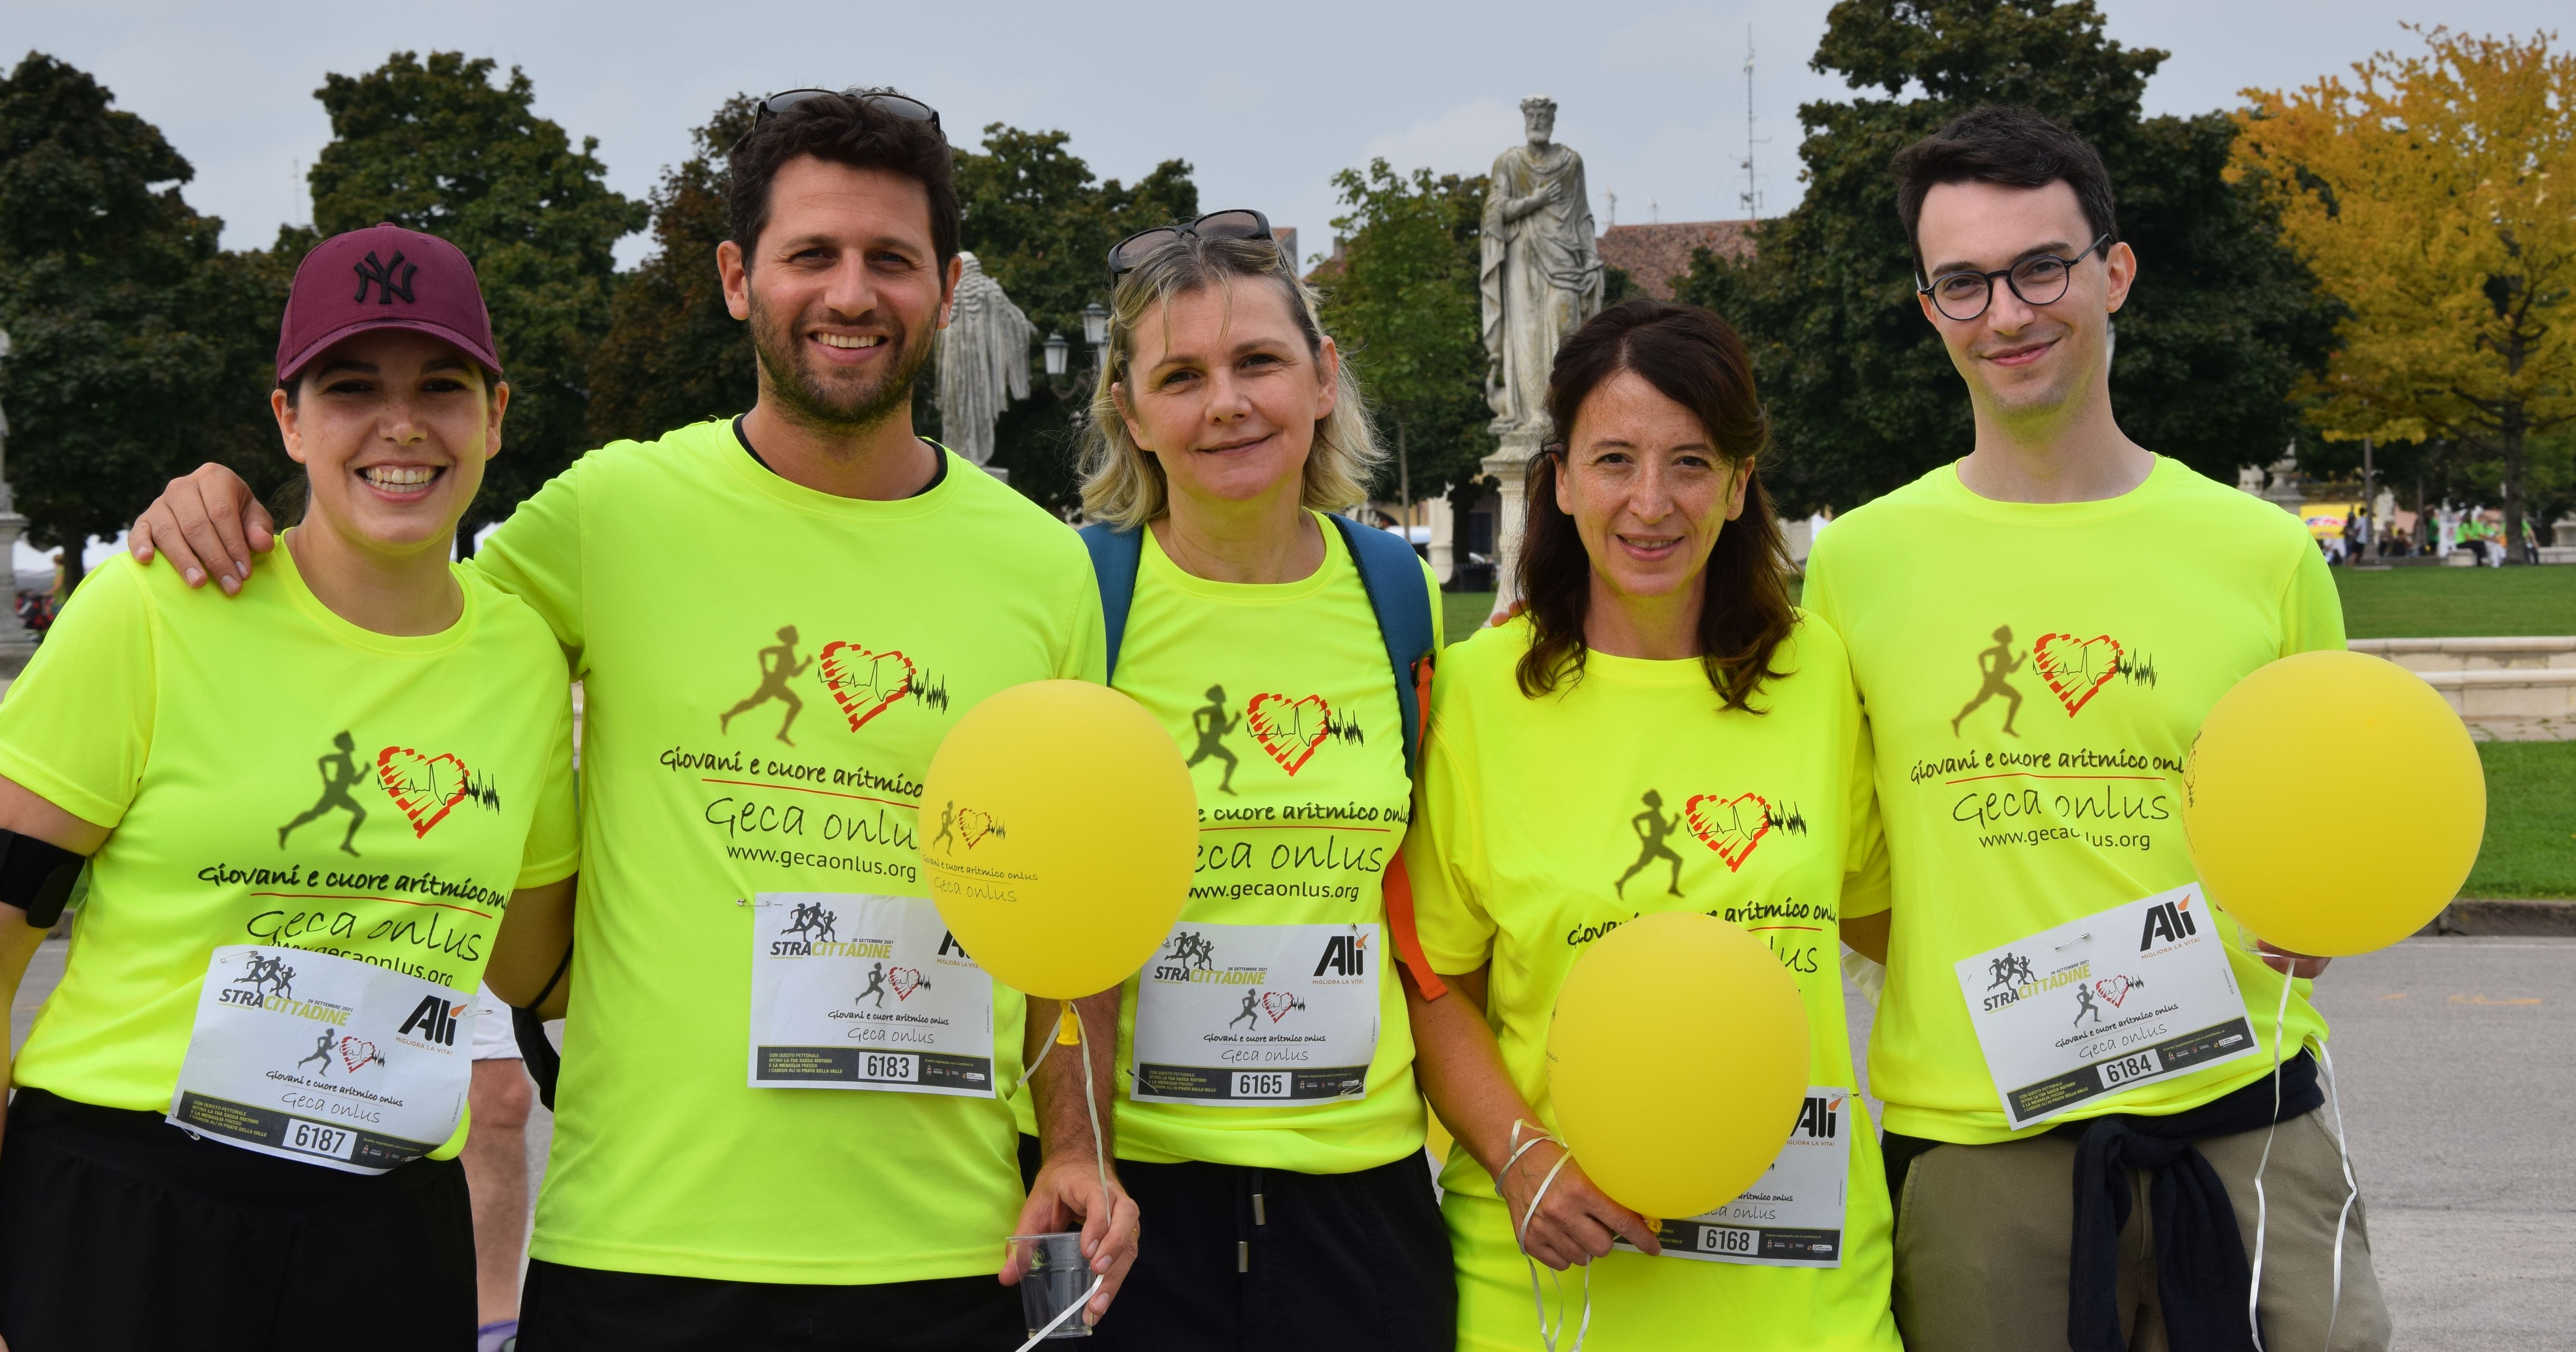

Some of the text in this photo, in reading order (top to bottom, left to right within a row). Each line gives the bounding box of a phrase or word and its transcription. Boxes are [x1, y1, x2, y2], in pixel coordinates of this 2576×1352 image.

[660, 746, 923, 798] Giovani e cuore aritmico
[1911, 748, 2185, 784] Giovani e cuore aritmico onl
[1199, 809, 1206, 822] e
[1214, 805, 1276, 821] cuore
[1283, 802, 1378, 821] aritmico
[1953, 789, 2042, 830] Geca
[2055, 785, 2169, 820] onlus
[705, 797, 919, 850] Geca onlu
[727, 845, 917, 883] www.gecaonlus.org
[1195, 835, 1382, 872] eca onlus
[946, 863, 964, 873] cuore
[967, 865, 1004, 879] aritmico
[1008, 871, 1038, 881] onlus
[198, 864, 300, 887] Giovani
[308, 868, 319, 886] e
[326, 871, 390, 891] cuore
[394, 872, 488, 904] aritmico
[934, 877, 1017, 902] Geca onlus
[1725, 896, 1809, 923] aritmico
[247, 910, 481, 961] Geca onlus
[2141, 947, 2172, 959] MIGLIORA
[2057, 963, 2079, 973] SETTEMBRE
[314, 1000, 341, 1009] SETTEMBRE
[828, 1010, 864, 1019] Giovani
[896, 1013, 928, 1024] aritmico
[930, 1017, 949, 1025] onlus
[2056, 1030, 2088, 1048] Giovani
[2096, 1023, 2117, 1034] cuore
[2118, 1012, 2153, 1027] aritmico
[2155, 1004, 2178, 1015] onlus
[395, 1036, 424, 1049] MIGLIORA
[847, 1028, 934, 1044] Geca onlus
[1204, 1034, 1238, 1042] Giovani
[2079, 1024, 2167, 1059] Geca onlus
[1221, 1048, 1309, 1064] Geca onlus
[867, 1056, 910, 1079] 6183
[2106, 1055, 2152, 1083] 6184
[266, 1070, 304, 1084] Giovani
[313, 1081, 337, 1092] cuore
[339, 1086, 377, 1100] aritmico
[379, 1095, 403, 1107] onlus
[1240, 1074, 1283, 1095] 6165
[192, 1115, 209, 1123] CAMION
[201, 1113, 224, 1121] MEDAGLIA
[221, 1107, 247, 1116] PETTORALE
[282, 1093, 380, 1123] Geca onlus
[239, 1116, 259, 1124] RISTORO
[294, 1124, 346, 1154] 6187
[1734, 1206, 1776, 1219] onlus
[1706, 1229, 1750, 1251] 6168
